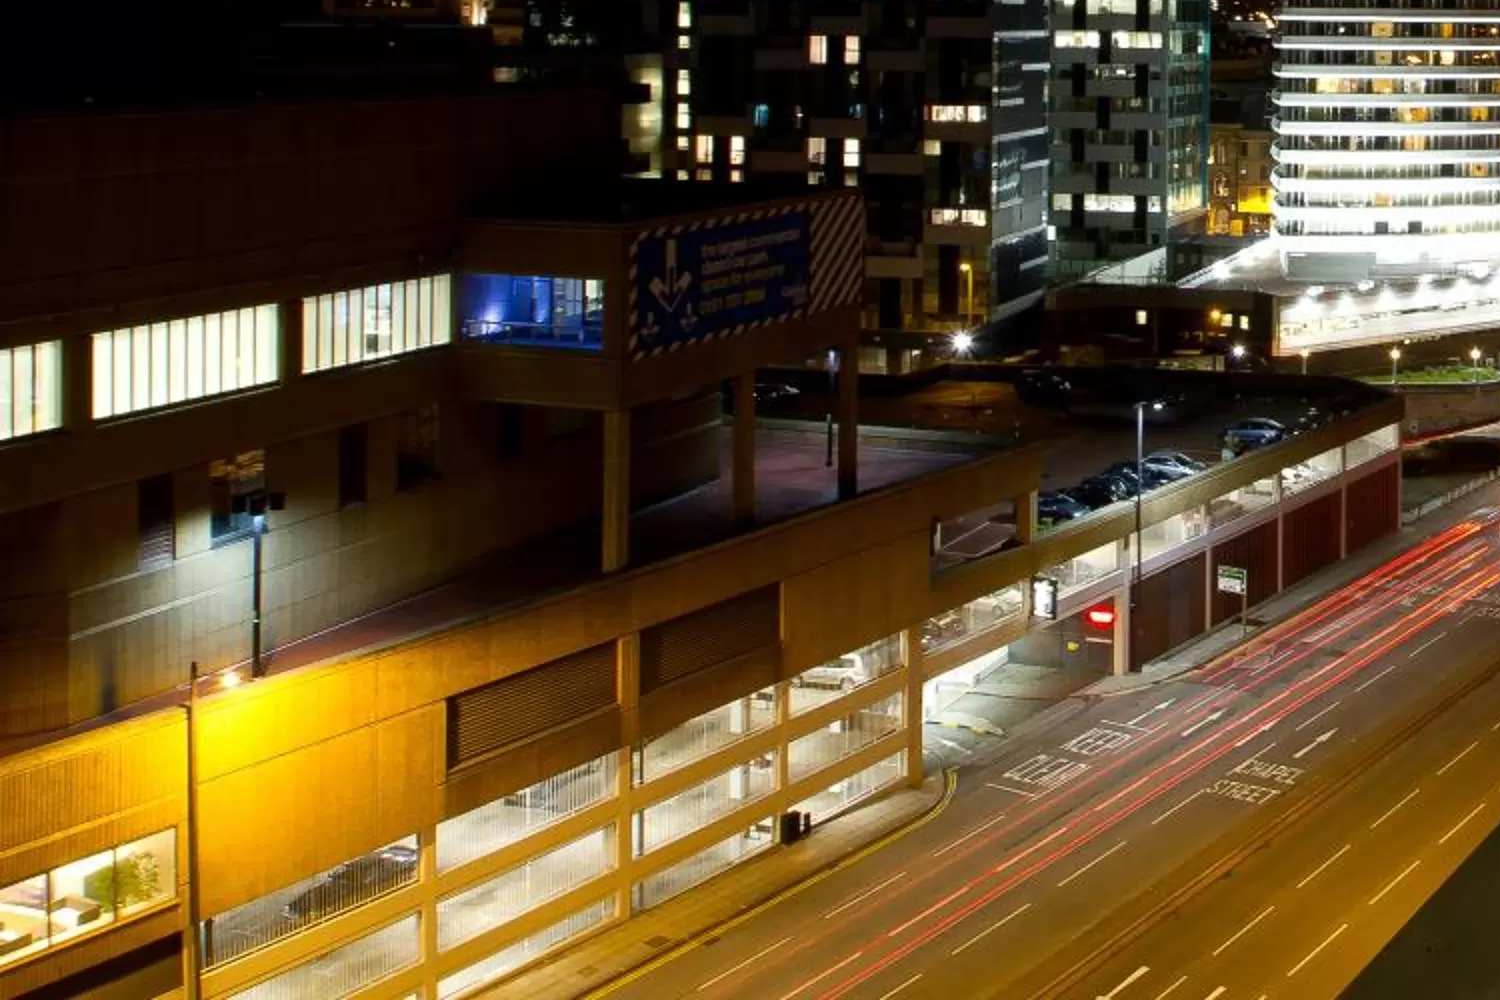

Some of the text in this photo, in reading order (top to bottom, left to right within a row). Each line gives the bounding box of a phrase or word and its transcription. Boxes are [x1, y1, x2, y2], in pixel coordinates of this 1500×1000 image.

[1058, 727, 1130, 755] KEEP
[1002, 754, 1093, 789] CLEAR
[1230, 757, 1304, 785] CHAPEL
[1211, 780, 1281, 806] STREET
